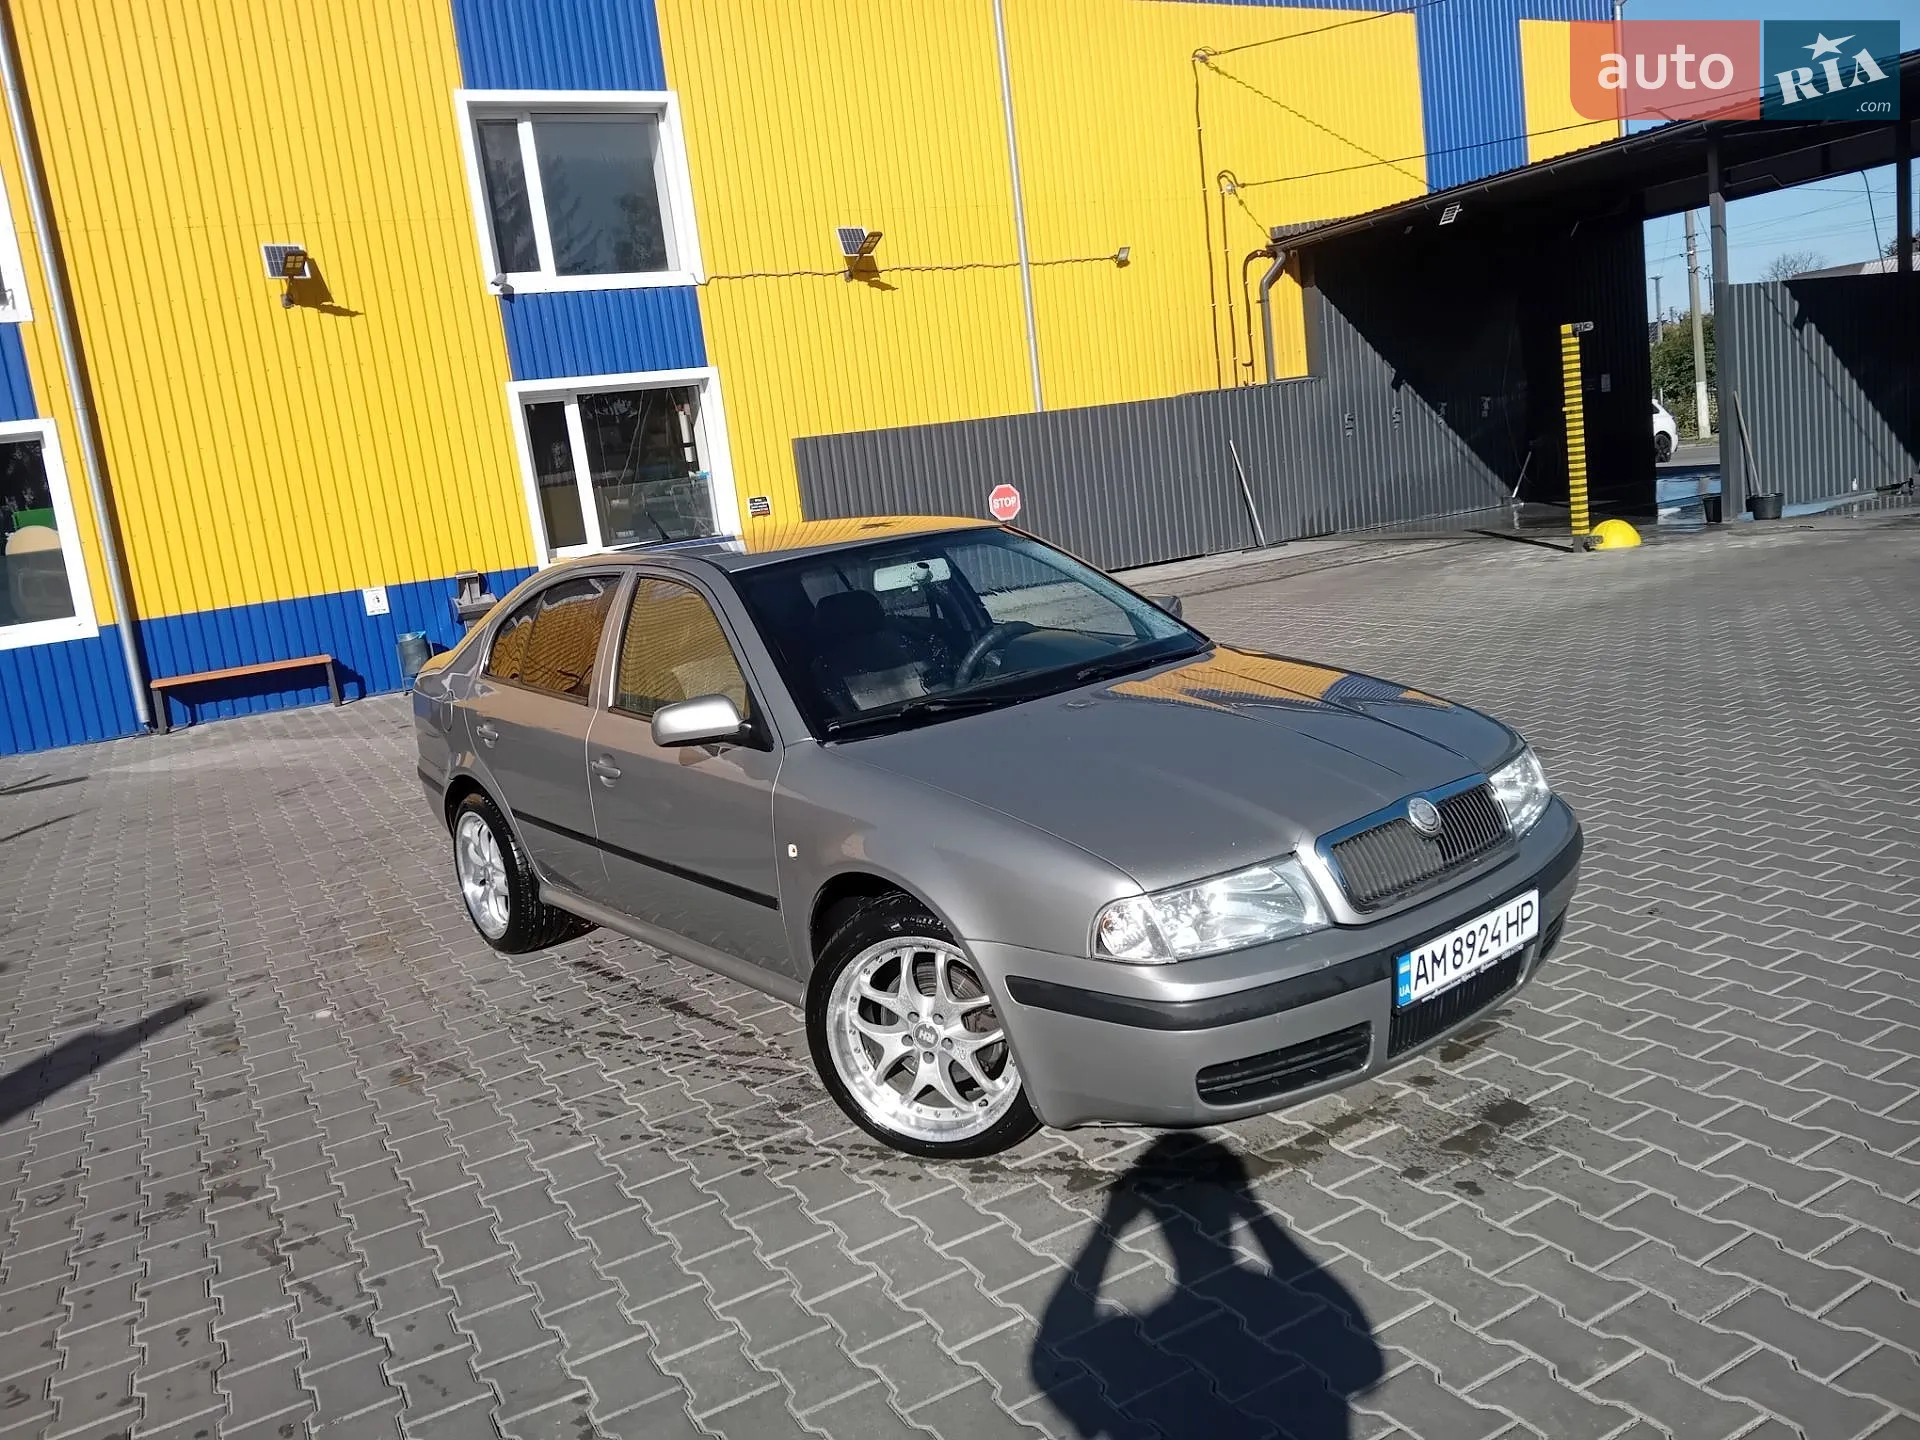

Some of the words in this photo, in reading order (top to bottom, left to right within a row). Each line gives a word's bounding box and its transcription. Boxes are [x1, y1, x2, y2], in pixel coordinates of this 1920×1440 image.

[993, 495, 1017, 509] STOP
[1414, 943, 1448, 991] AM
[1452, 915, 1502, 970] 8924
[1506, 900, 1534, 943] HP
[1400, 984, 1411, 997] UA
